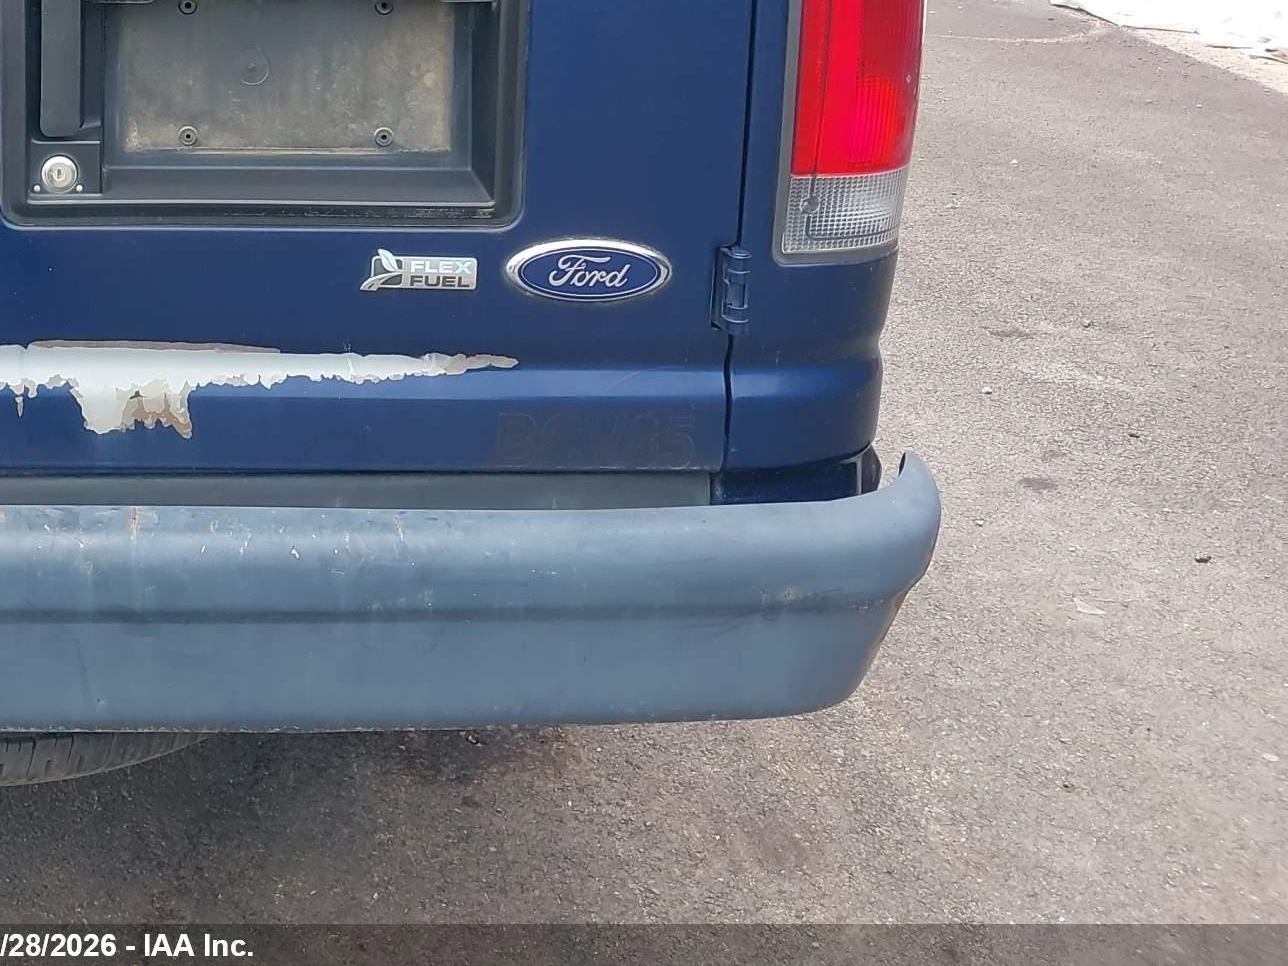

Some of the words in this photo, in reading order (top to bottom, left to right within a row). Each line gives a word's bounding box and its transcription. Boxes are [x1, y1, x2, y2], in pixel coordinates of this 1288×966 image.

[411, 260, 473, 274] FLEX
[548, 254, 631, 288] Ford
[409, 275, 471, 288] FUEL
